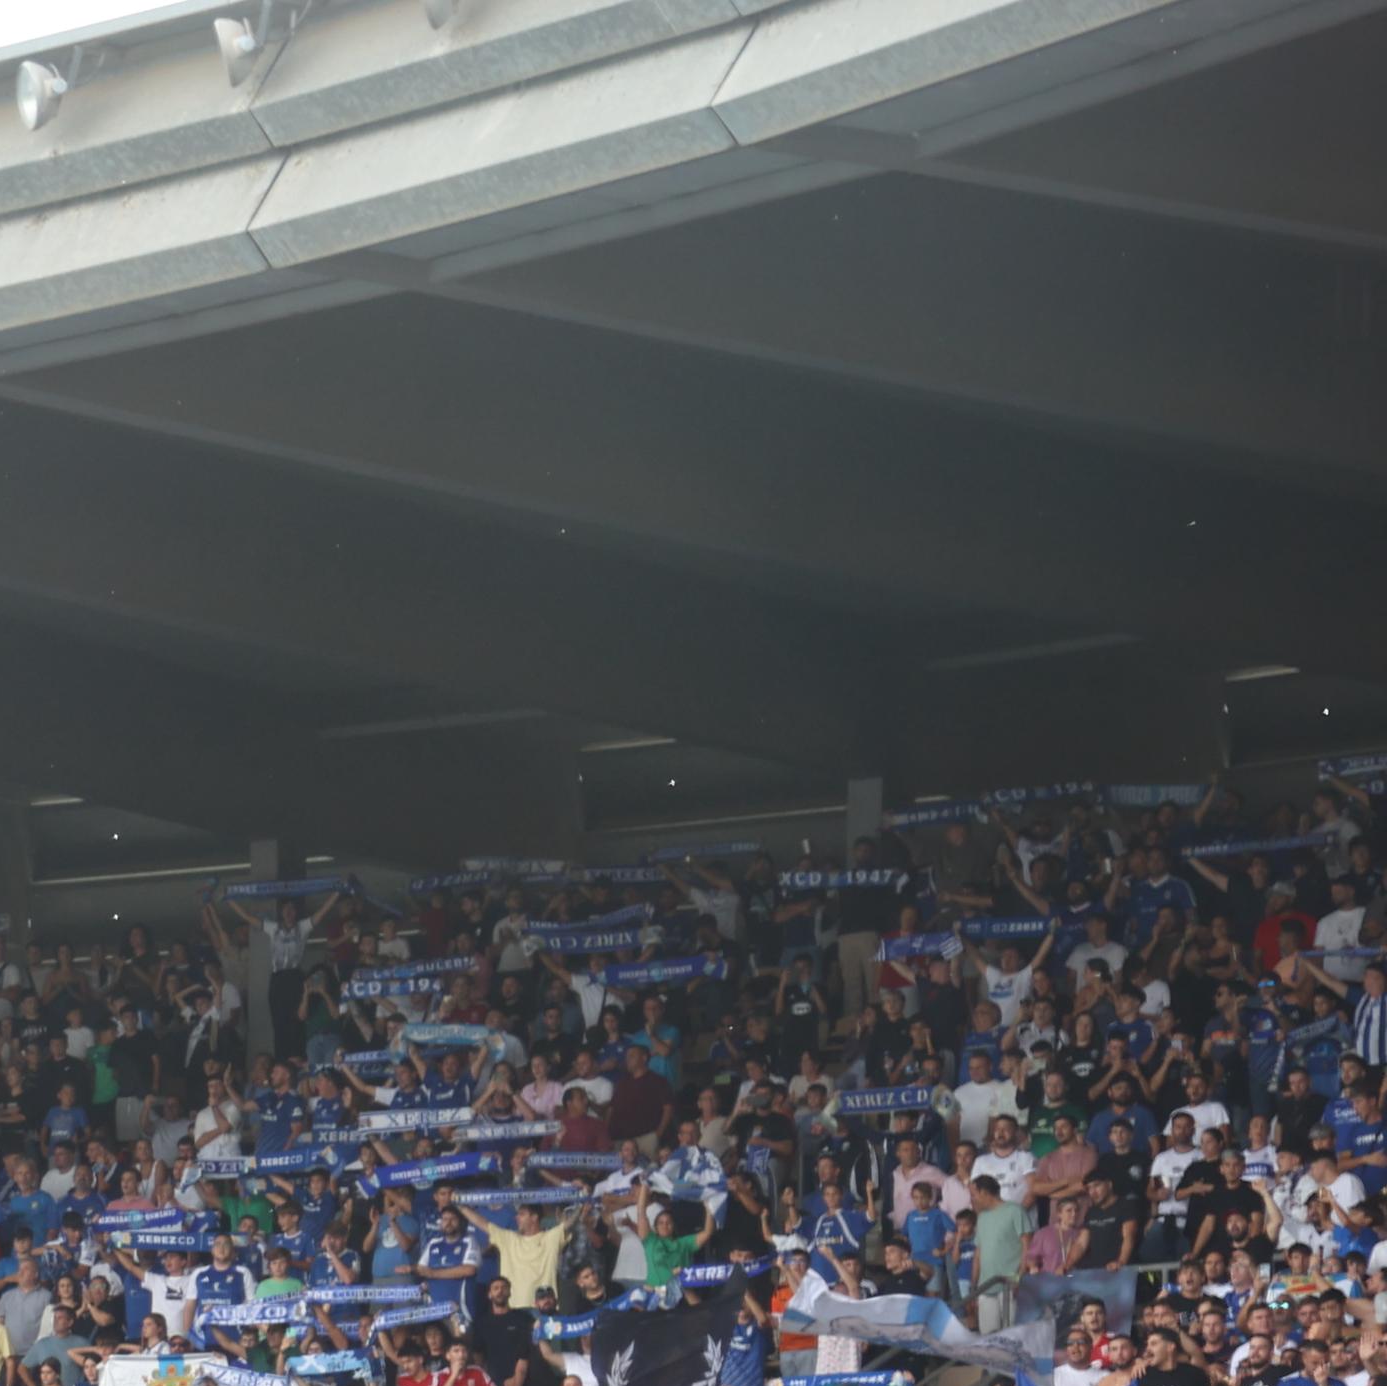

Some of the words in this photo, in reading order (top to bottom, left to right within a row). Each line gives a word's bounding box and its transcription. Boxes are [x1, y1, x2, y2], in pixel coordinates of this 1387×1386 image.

[779, 870, 822, 886] XCD
[846, 870, 893, 884] 1947
[842, 1092, 893, 1109] XEREZ
